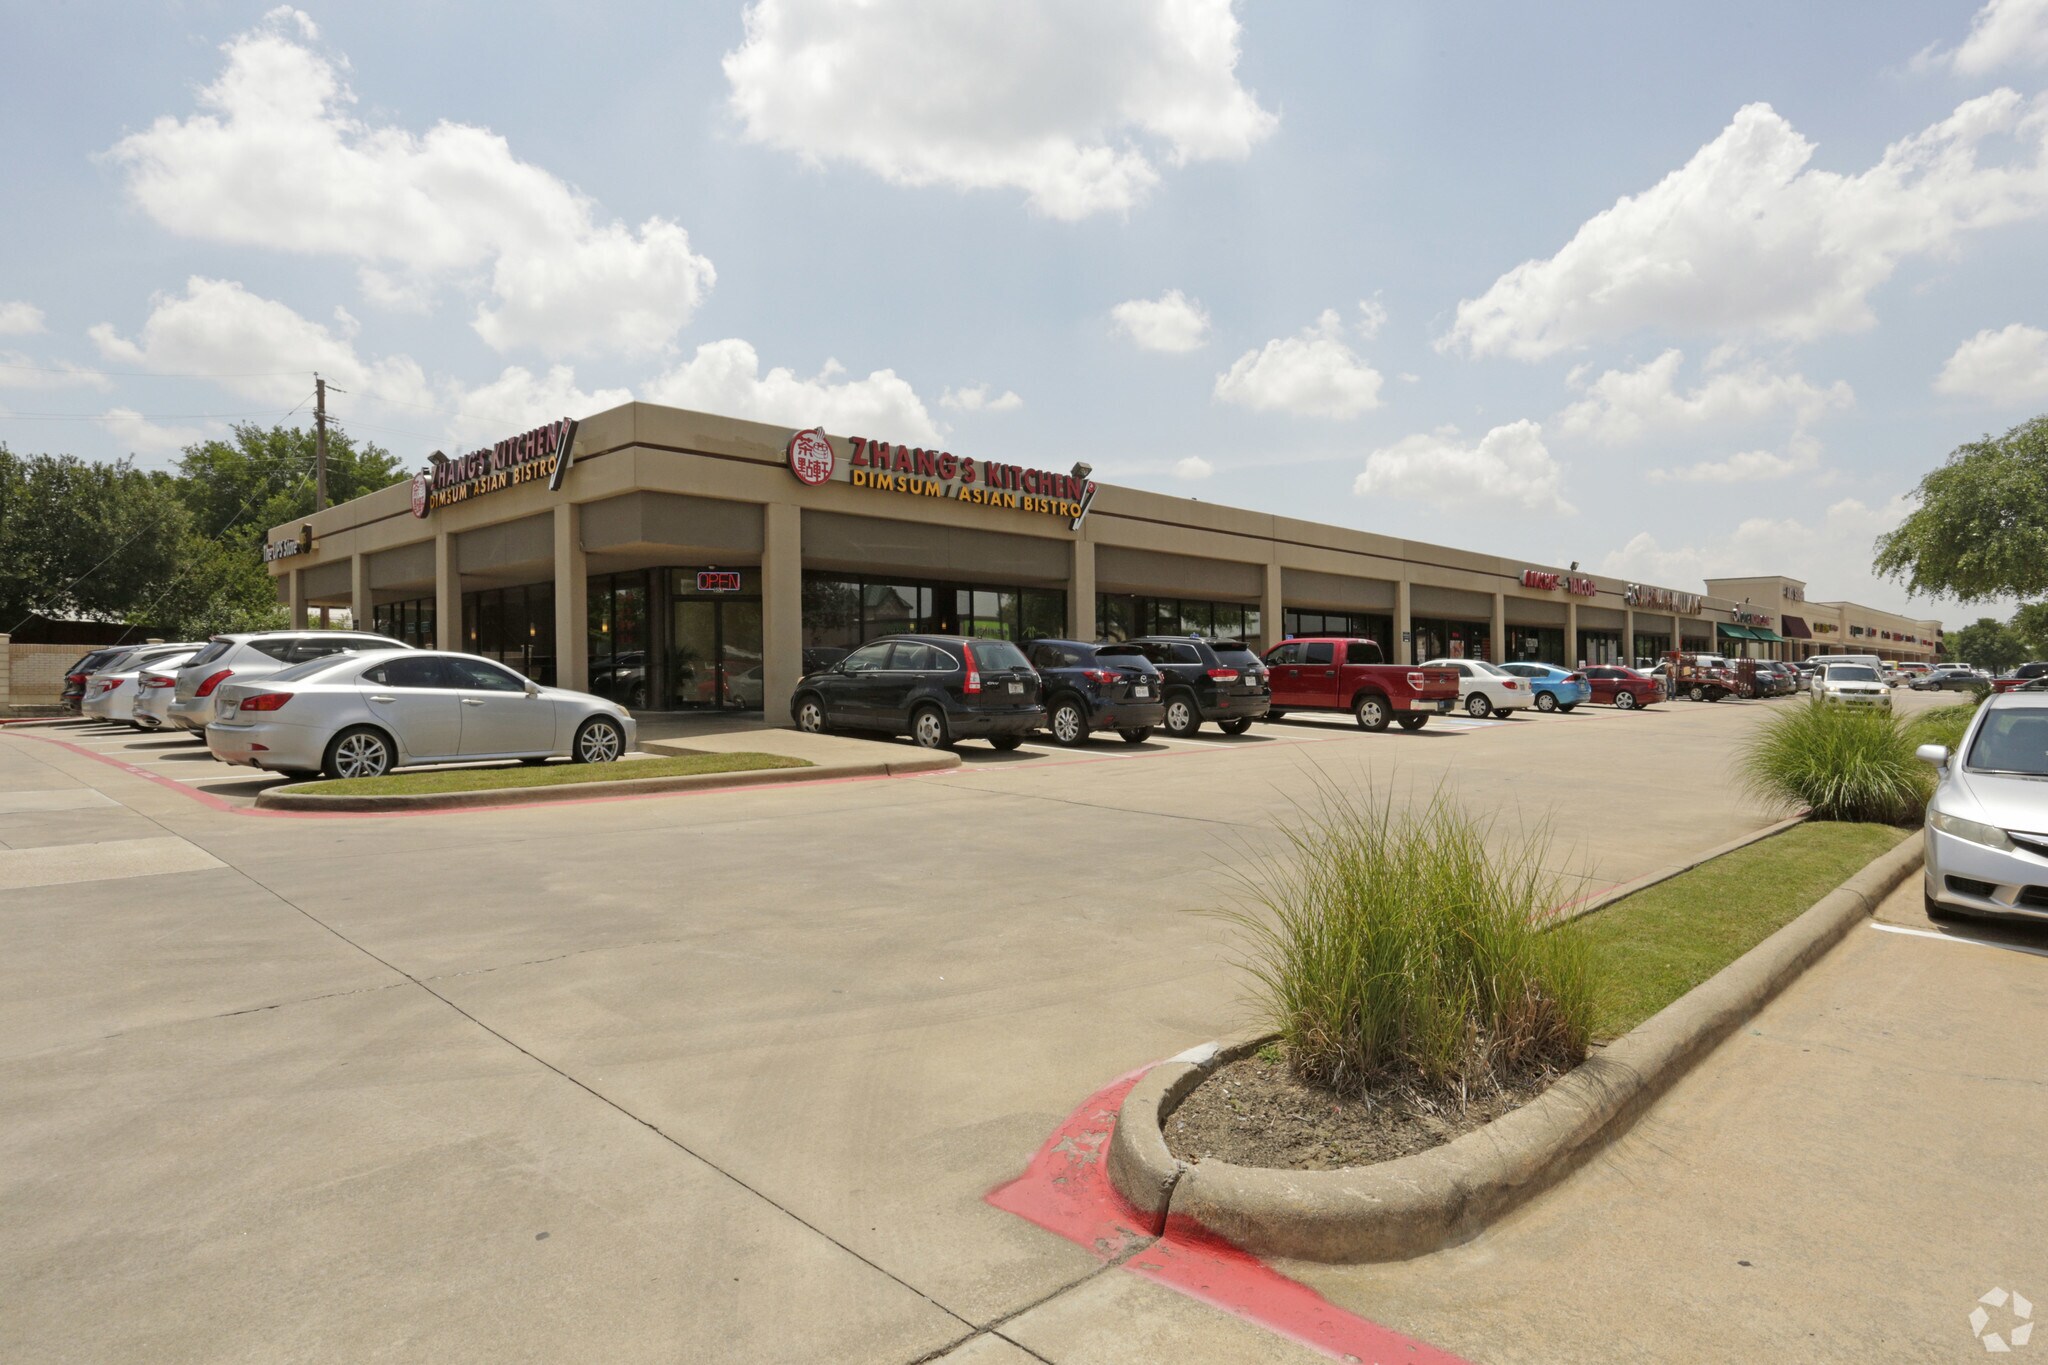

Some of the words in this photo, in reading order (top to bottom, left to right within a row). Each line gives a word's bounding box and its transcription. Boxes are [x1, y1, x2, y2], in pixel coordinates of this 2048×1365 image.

[493, 420, 561, 470] KITCHEN
[850, 436, 976, 484] ZHANG'S
[986, 461, 1081, 500] KITCHEN
[429, 484, 468, 509] DIMSUM
[473, 471, 507, 496] ASIAN
[513, 456, 557, 485] BISTRO
[852, 469, 941, 498] DIMSUM
[958, 485, 1016, 509] ASIAN
[1023, 496, 1082, 518] BISTRO
[699, 573, 739, 590] OPEN
[1569, 576, 1597, 597] TAILOR
